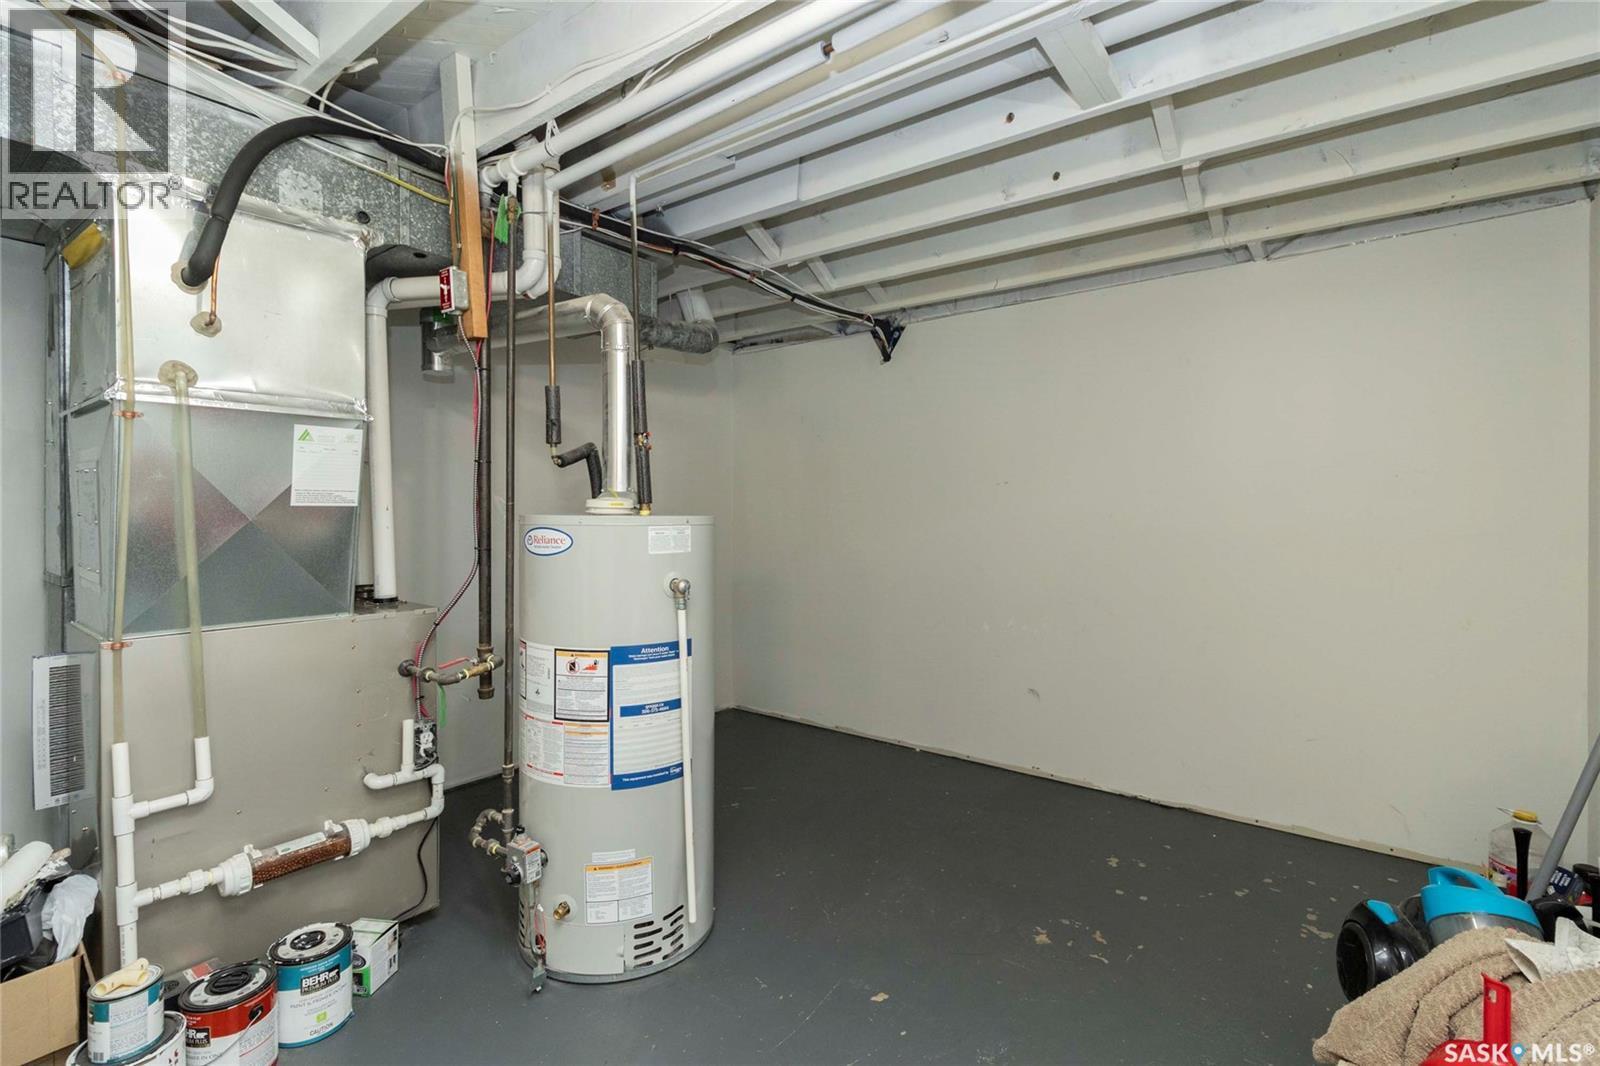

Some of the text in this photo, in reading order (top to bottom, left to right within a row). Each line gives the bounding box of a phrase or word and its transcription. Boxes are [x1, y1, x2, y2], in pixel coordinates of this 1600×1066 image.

[533, 535, 566, 545] Reliance
[641, 645, 669, 654] Attention
[302, 971, 330, 987] BEHR
[309, 1022, 334, 1036] CAUTION
